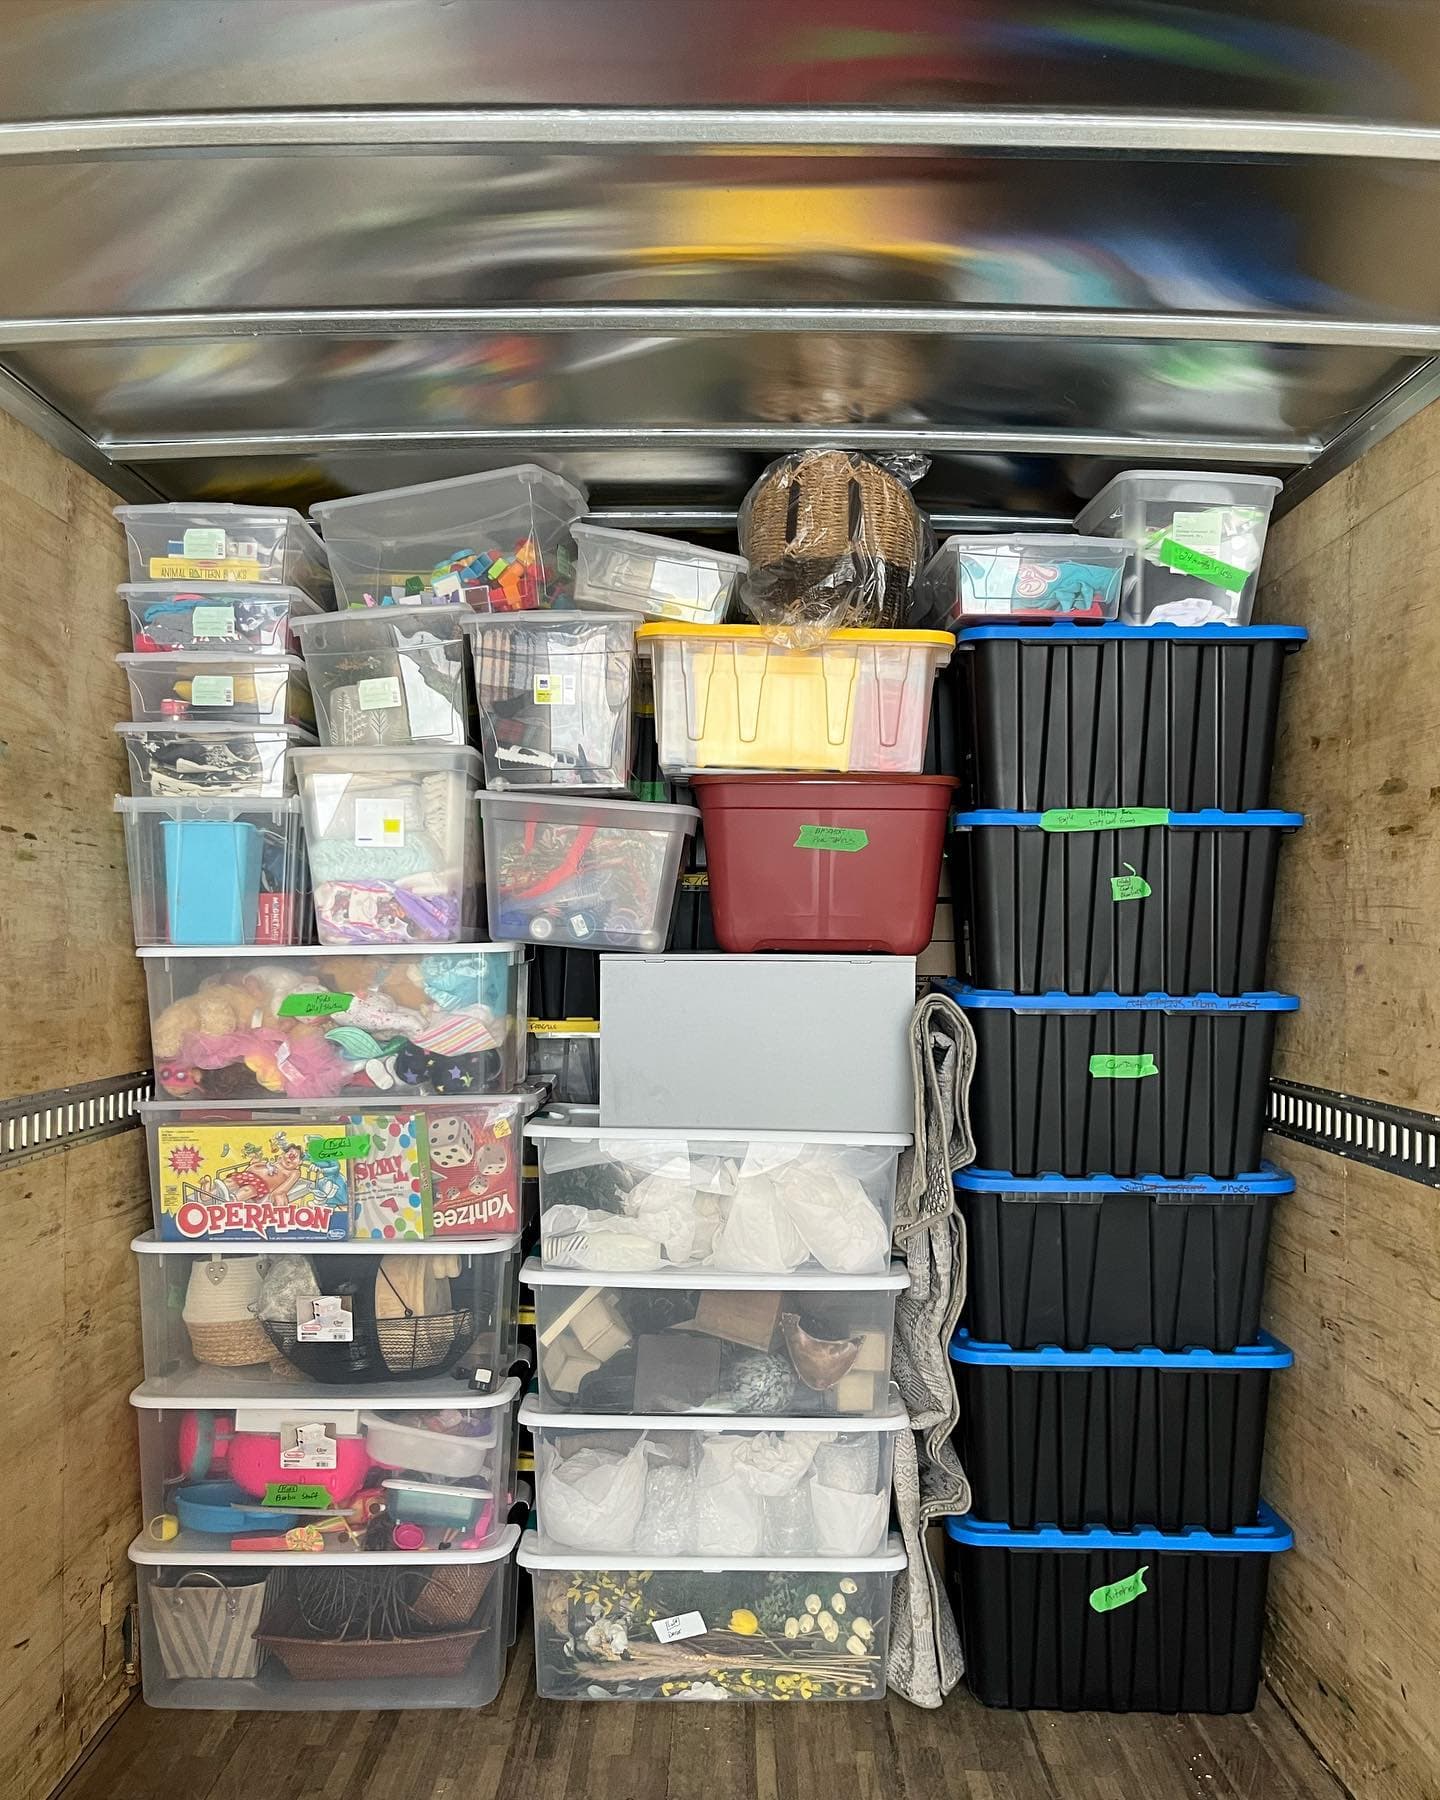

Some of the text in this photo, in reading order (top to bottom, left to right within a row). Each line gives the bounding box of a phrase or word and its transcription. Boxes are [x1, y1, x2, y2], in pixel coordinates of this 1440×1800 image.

[160, 568, 186, 578] ANIMAL
[188, 568, 220, 579] PATTERN
[176, 1202, 333, 1238] OPERATION
[433, 1194, 514, 1228] Yahtzee
